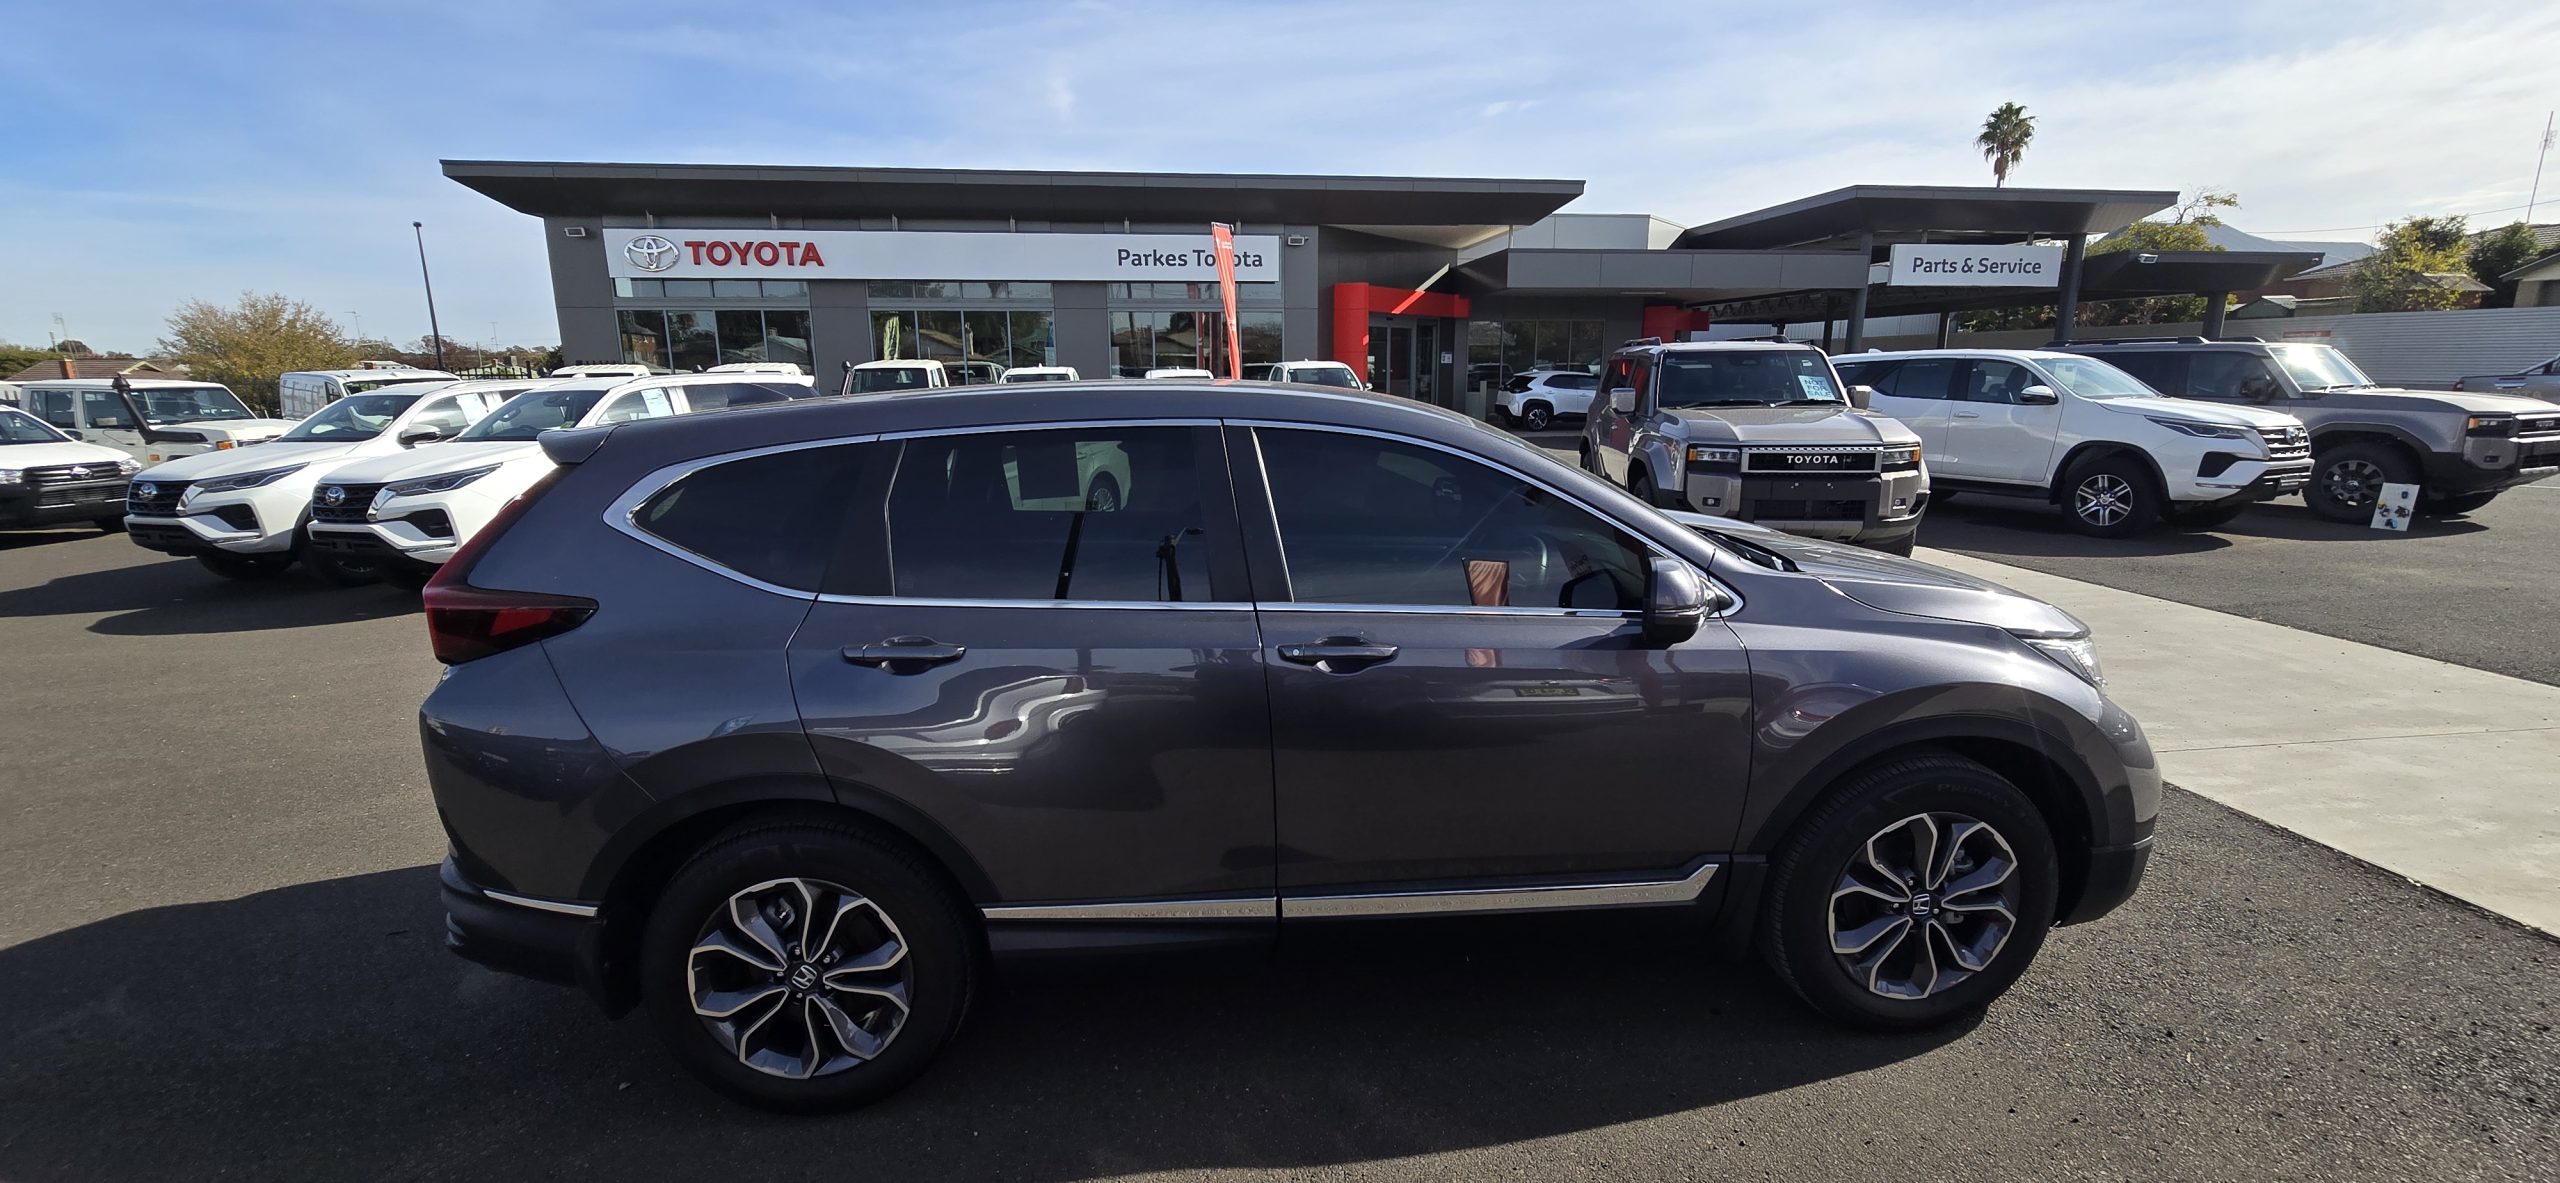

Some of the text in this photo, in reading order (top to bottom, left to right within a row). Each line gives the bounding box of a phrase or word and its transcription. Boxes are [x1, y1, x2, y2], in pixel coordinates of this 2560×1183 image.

[684, 240, 825, 267] TOYOTA
[1117, 248, 1264, 267] Parkes Toota
[1912, 257, 2042, 274] Parts & Service
[1786, 455, 1839, 464] TOYOTA
